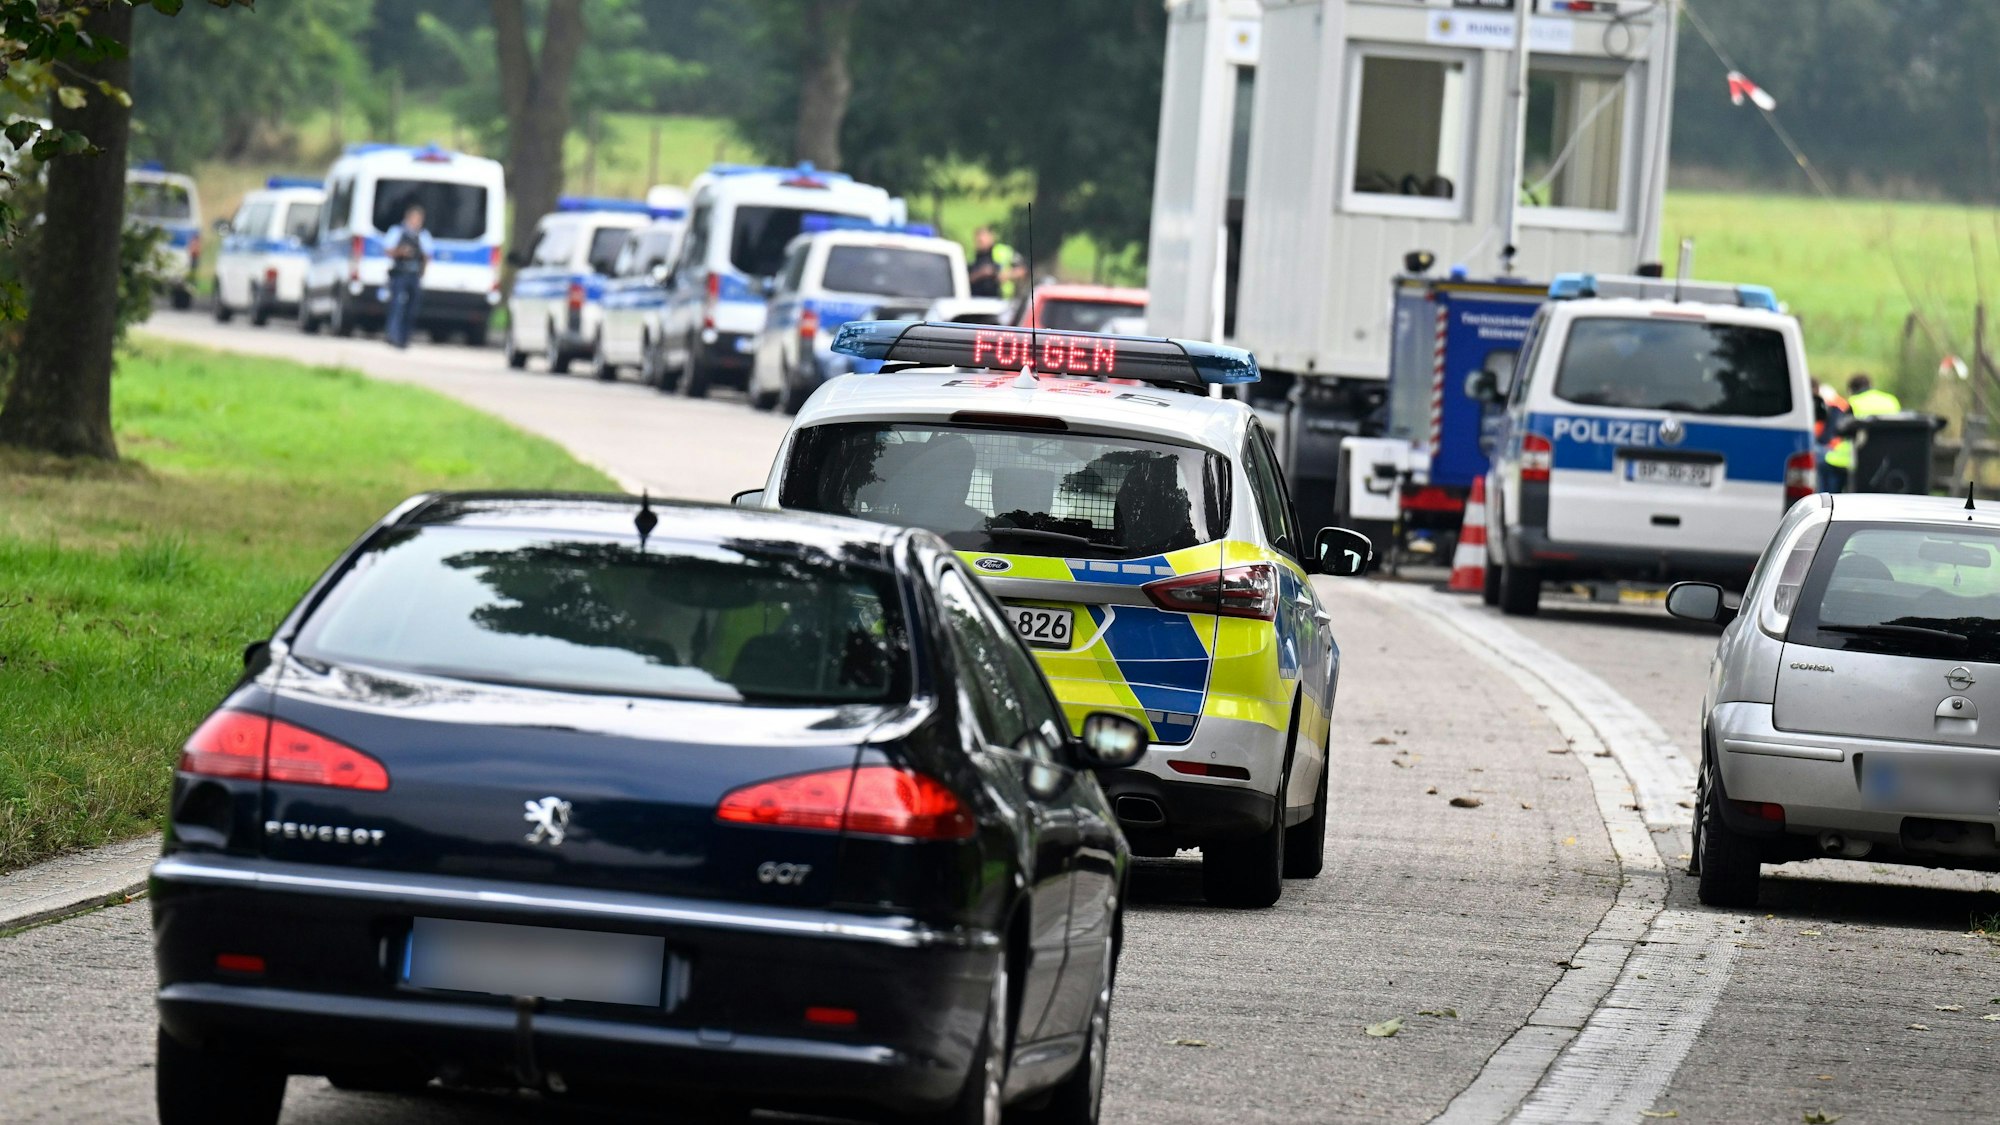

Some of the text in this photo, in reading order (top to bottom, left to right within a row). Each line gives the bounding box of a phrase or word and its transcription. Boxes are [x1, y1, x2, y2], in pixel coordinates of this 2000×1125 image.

[974, 330, 1115, 372] FOLGEN
[1553, 417, 1655, 446] POLIZEI
[1005, 610, 1067, 639] -826
[1790, 661, 1835, 673] CORSA
[264, 820, 386, 847] PEUGEOT
[757, 860, 812, 885] 607
